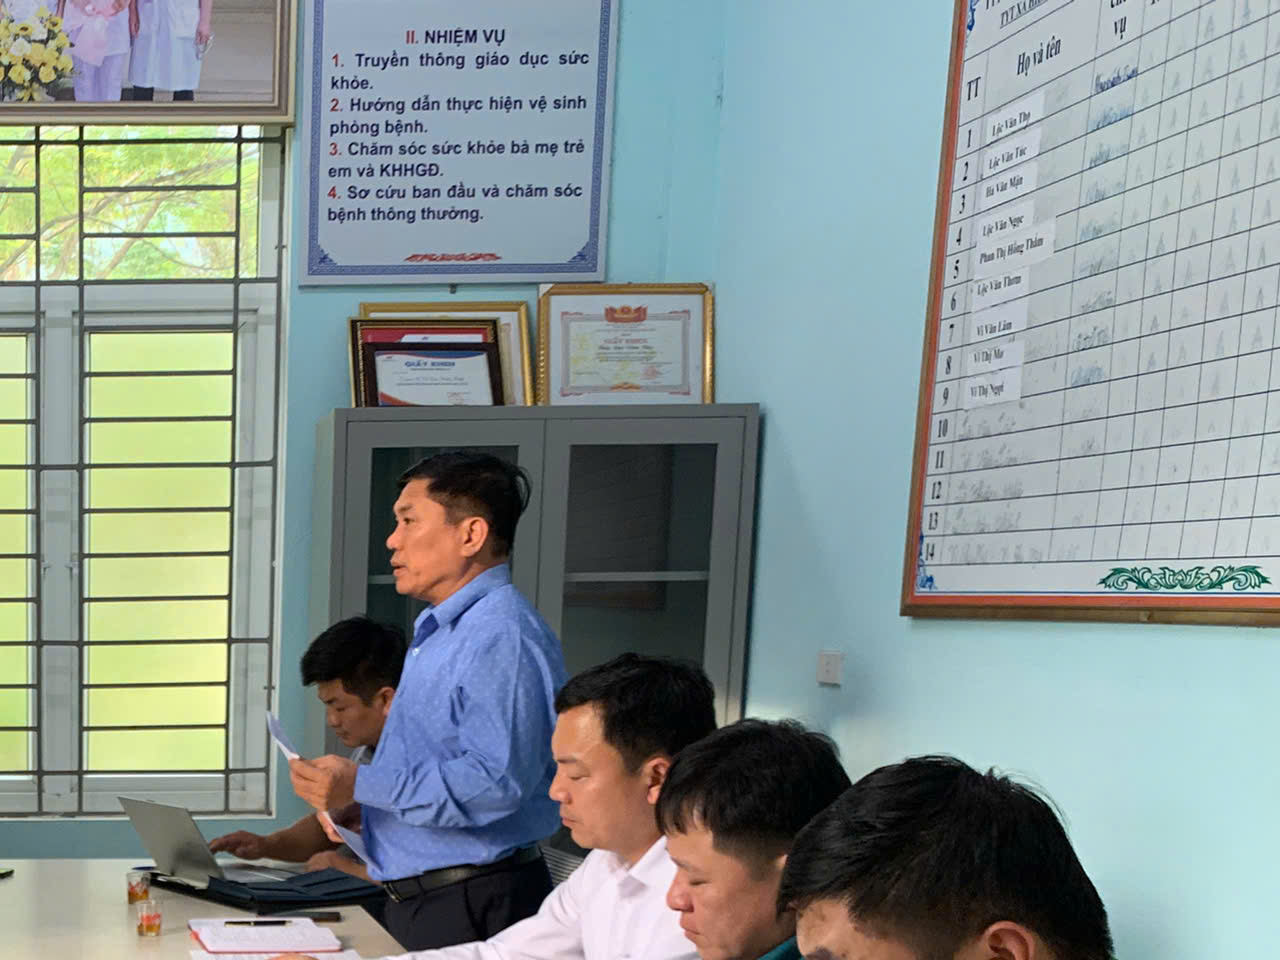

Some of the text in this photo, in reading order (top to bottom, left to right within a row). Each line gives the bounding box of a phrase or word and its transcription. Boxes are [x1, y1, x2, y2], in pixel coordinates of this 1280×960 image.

[406, 27, 505, 47] II. NHIỆM VỤ
[1114, 16, 1127, 40] vụ
[332, 50, 589, 70] 1. Truyền thông giáo dục sức
[1017, 35, 1061, 77] Họ và tên
[331, 75, 373, 90] khỏe.
[967, 76, 981, 101] TT
[330, 96, 587, 114] 2. Hướng dẫn thực hiện vệ sinh
[330, 119, 428, 137] phòng bệnh.
[330, 139, 584, 156] 3. Chăm sóc sức khỏe bà mẹ trẻ
[967, 129, 972, 148] 1
[328, 163, 444, 178] em và KHHGĐ.
[962, 161, 969, 181] 2
[327, 182, 582, 199] 4. Sơ cứu ban đầu và chăm sóc
[958, 194, 965, 214] 3
[328, 206, 483, 223] bệnh thông thường.
[956, 227, 962, 246] 4
[953, 259, 959, 279] 5
[950, 291, 957, 311] 6
[948, 323, 955, 343] 7
[945, 355, 952, 375] 8
[942, 387, 949, 407] 9
[938, 419, 948, 438] 10
[935, 450, 944, 469] 11
[932, 481, 942, 500] 12
[928, 511, 938, 530] 13
[925, 543, 935, 561] 14
